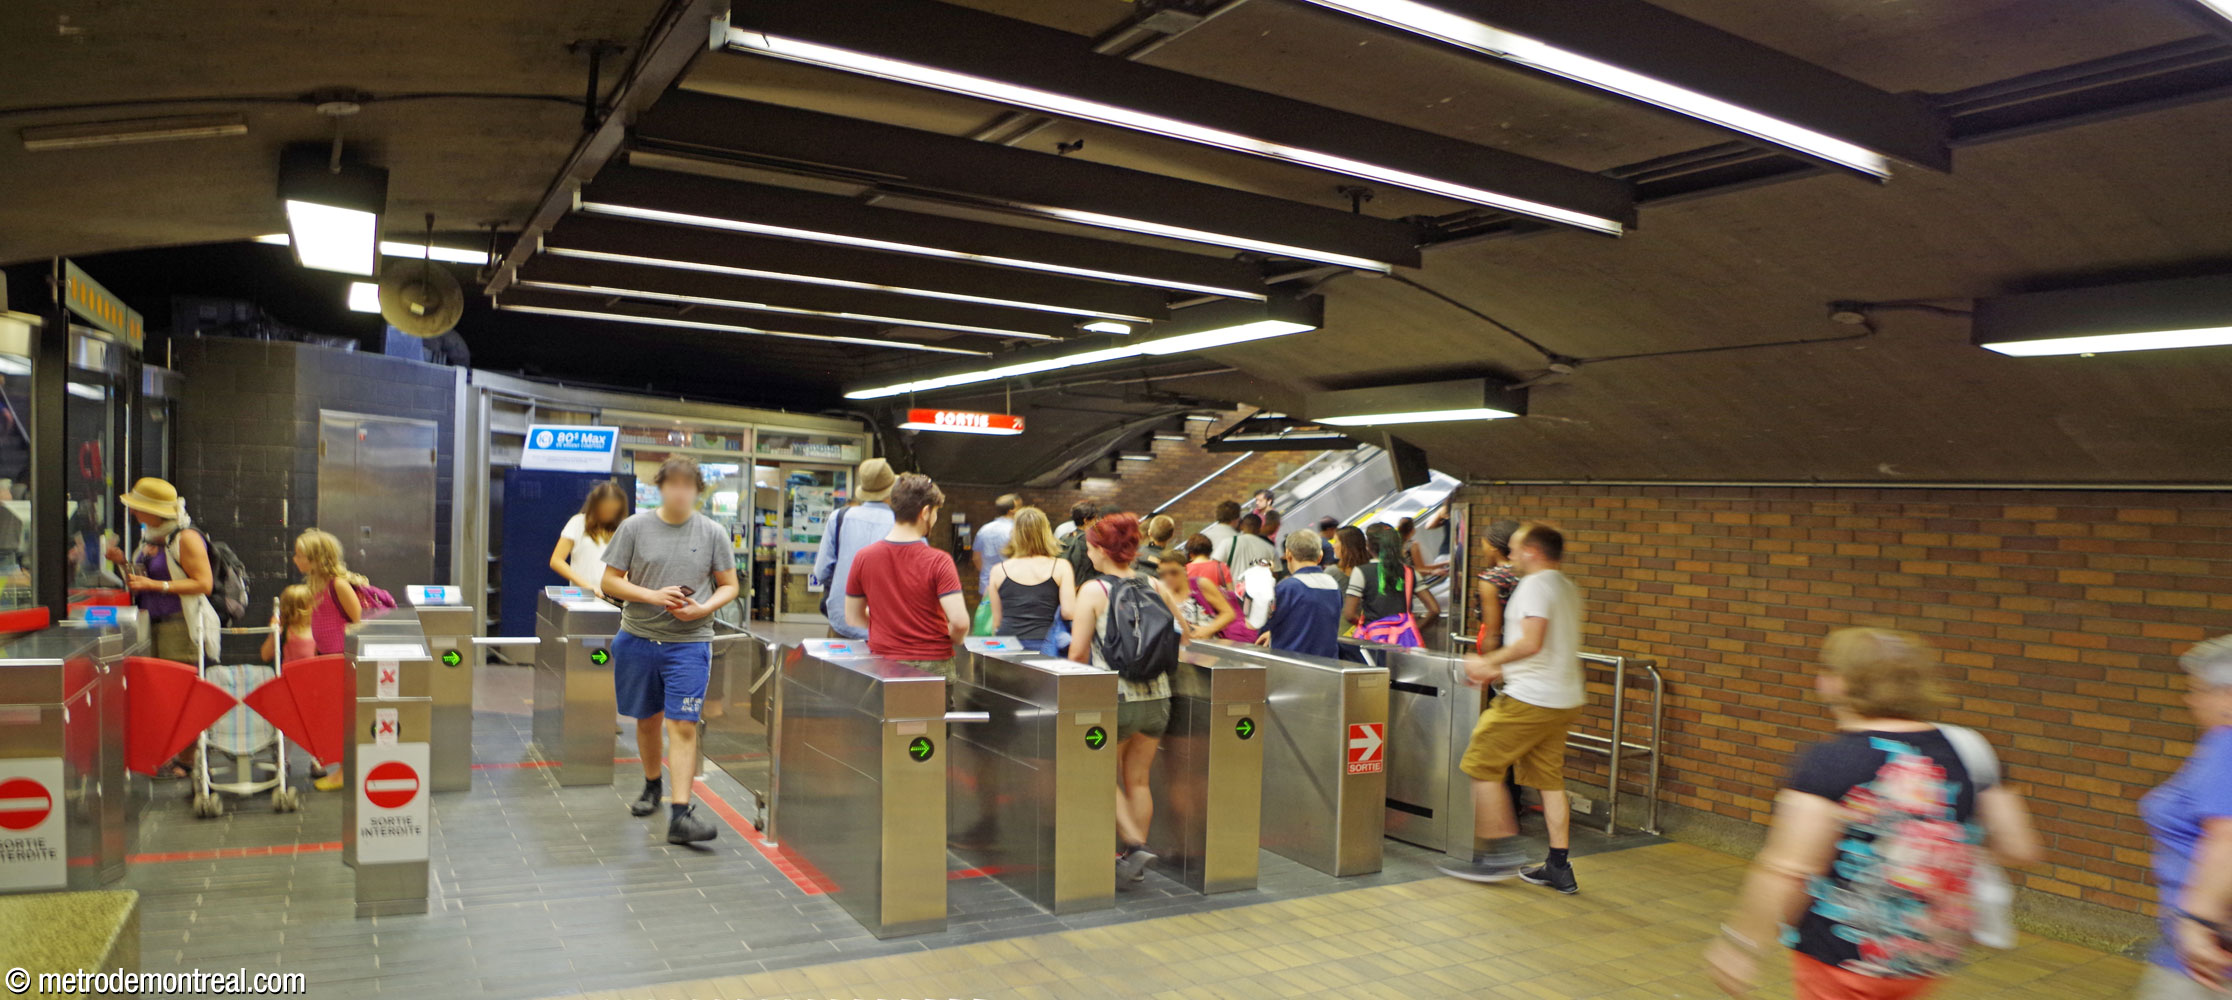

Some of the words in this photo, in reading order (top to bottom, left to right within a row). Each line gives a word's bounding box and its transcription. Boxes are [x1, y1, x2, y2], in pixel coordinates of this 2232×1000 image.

[934, 411, 989, 428] SORTIE
[581, 433, 606, 445] Max
[1350, 762, 1381, 772] SORTIE
[370, 815, 412, 826] SORTIE
[361, 825, 421, 839] INTERDITE
[0, 848, 57, 864] TERDITE
